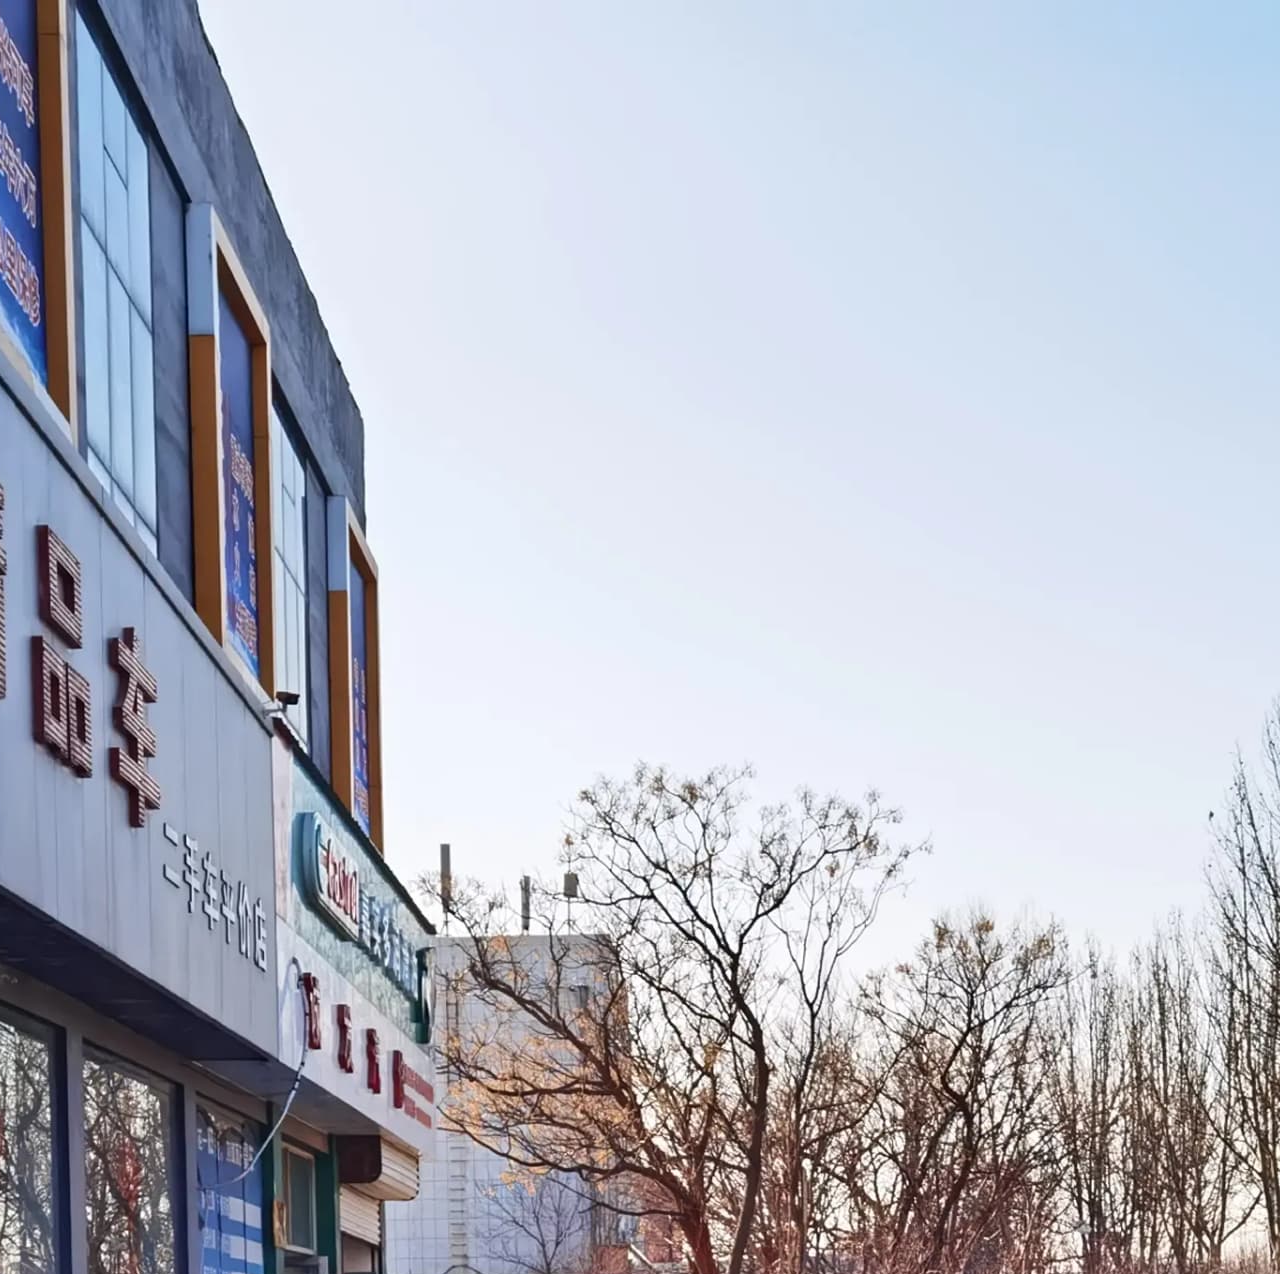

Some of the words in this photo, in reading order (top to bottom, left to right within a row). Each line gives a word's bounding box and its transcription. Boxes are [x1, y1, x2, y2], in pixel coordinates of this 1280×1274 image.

[163, 821, 267, 973] 二手车平价店
